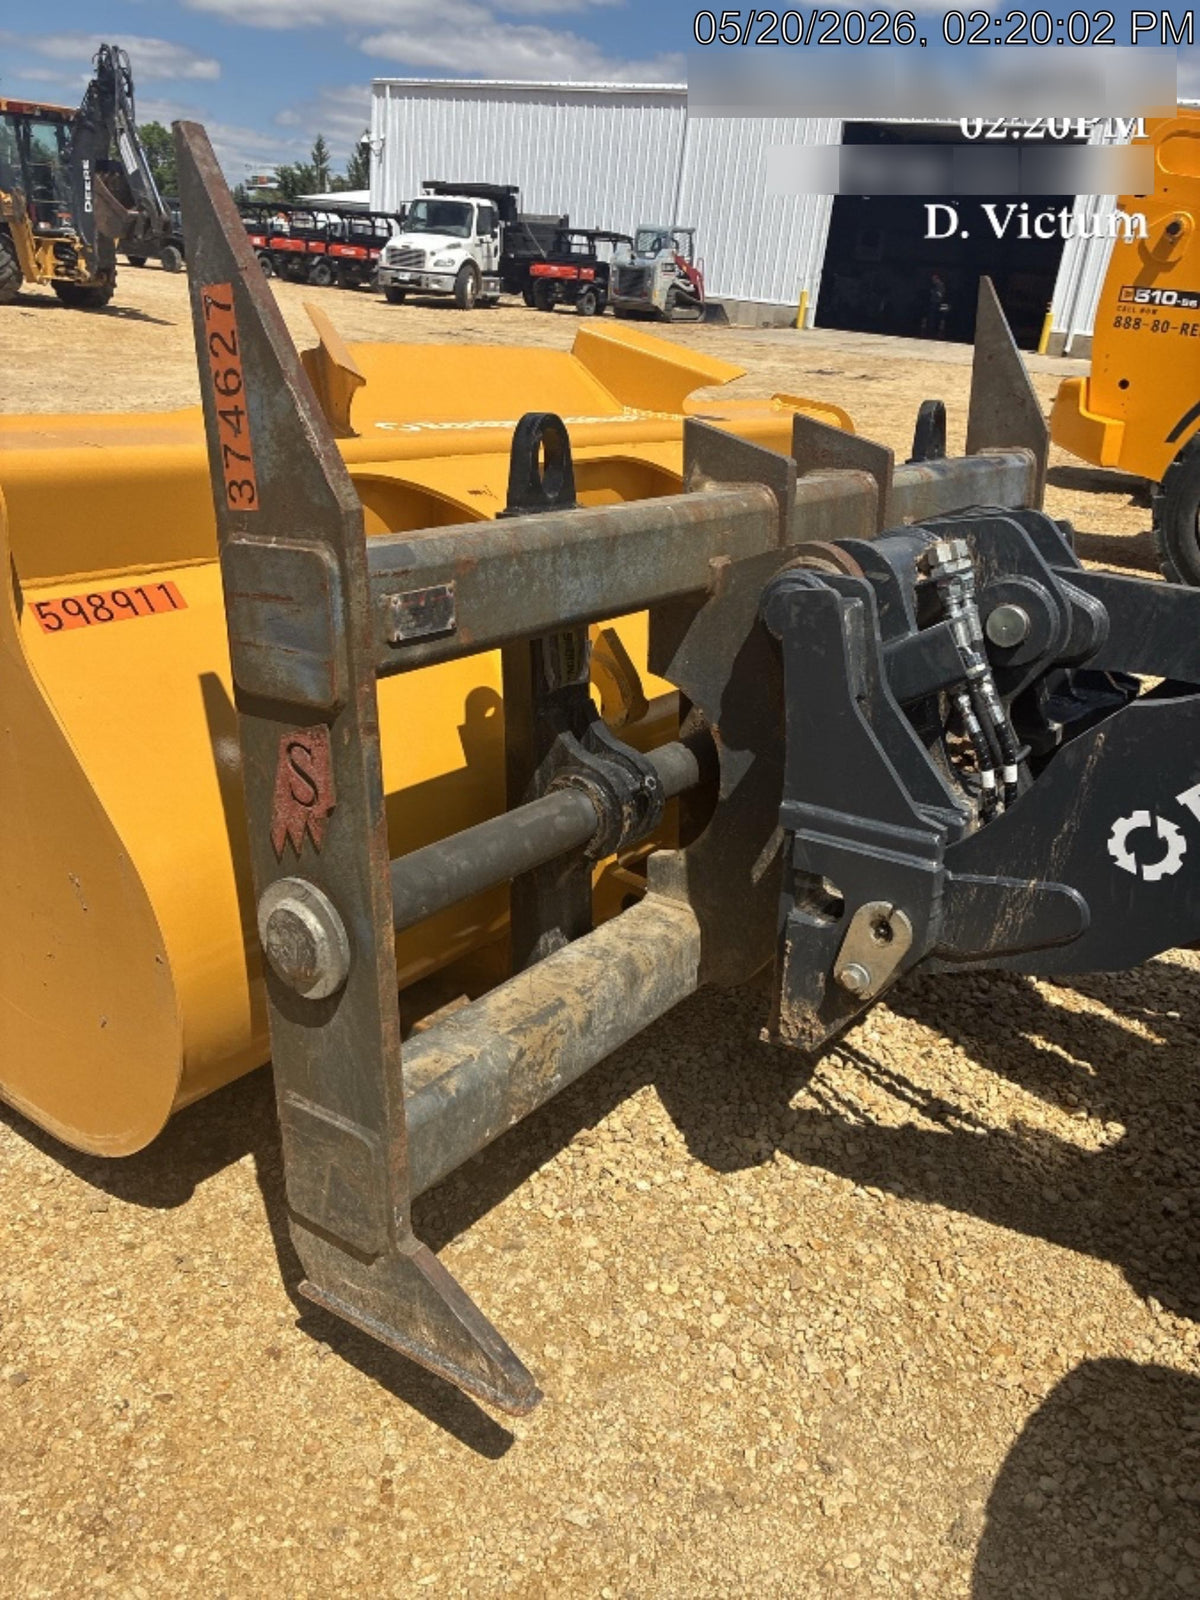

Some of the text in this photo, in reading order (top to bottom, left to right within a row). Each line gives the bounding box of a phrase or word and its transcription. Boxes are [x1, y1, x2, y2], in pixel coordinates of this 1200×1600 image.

[82, 159, 93, 213] DEERE
[1113, 315, 1200, 337] 888-80-RE
[204, 294, 256, 504] 374627
[34, 583, 178, 631] 598911
[286, 741, 318, 807] S
